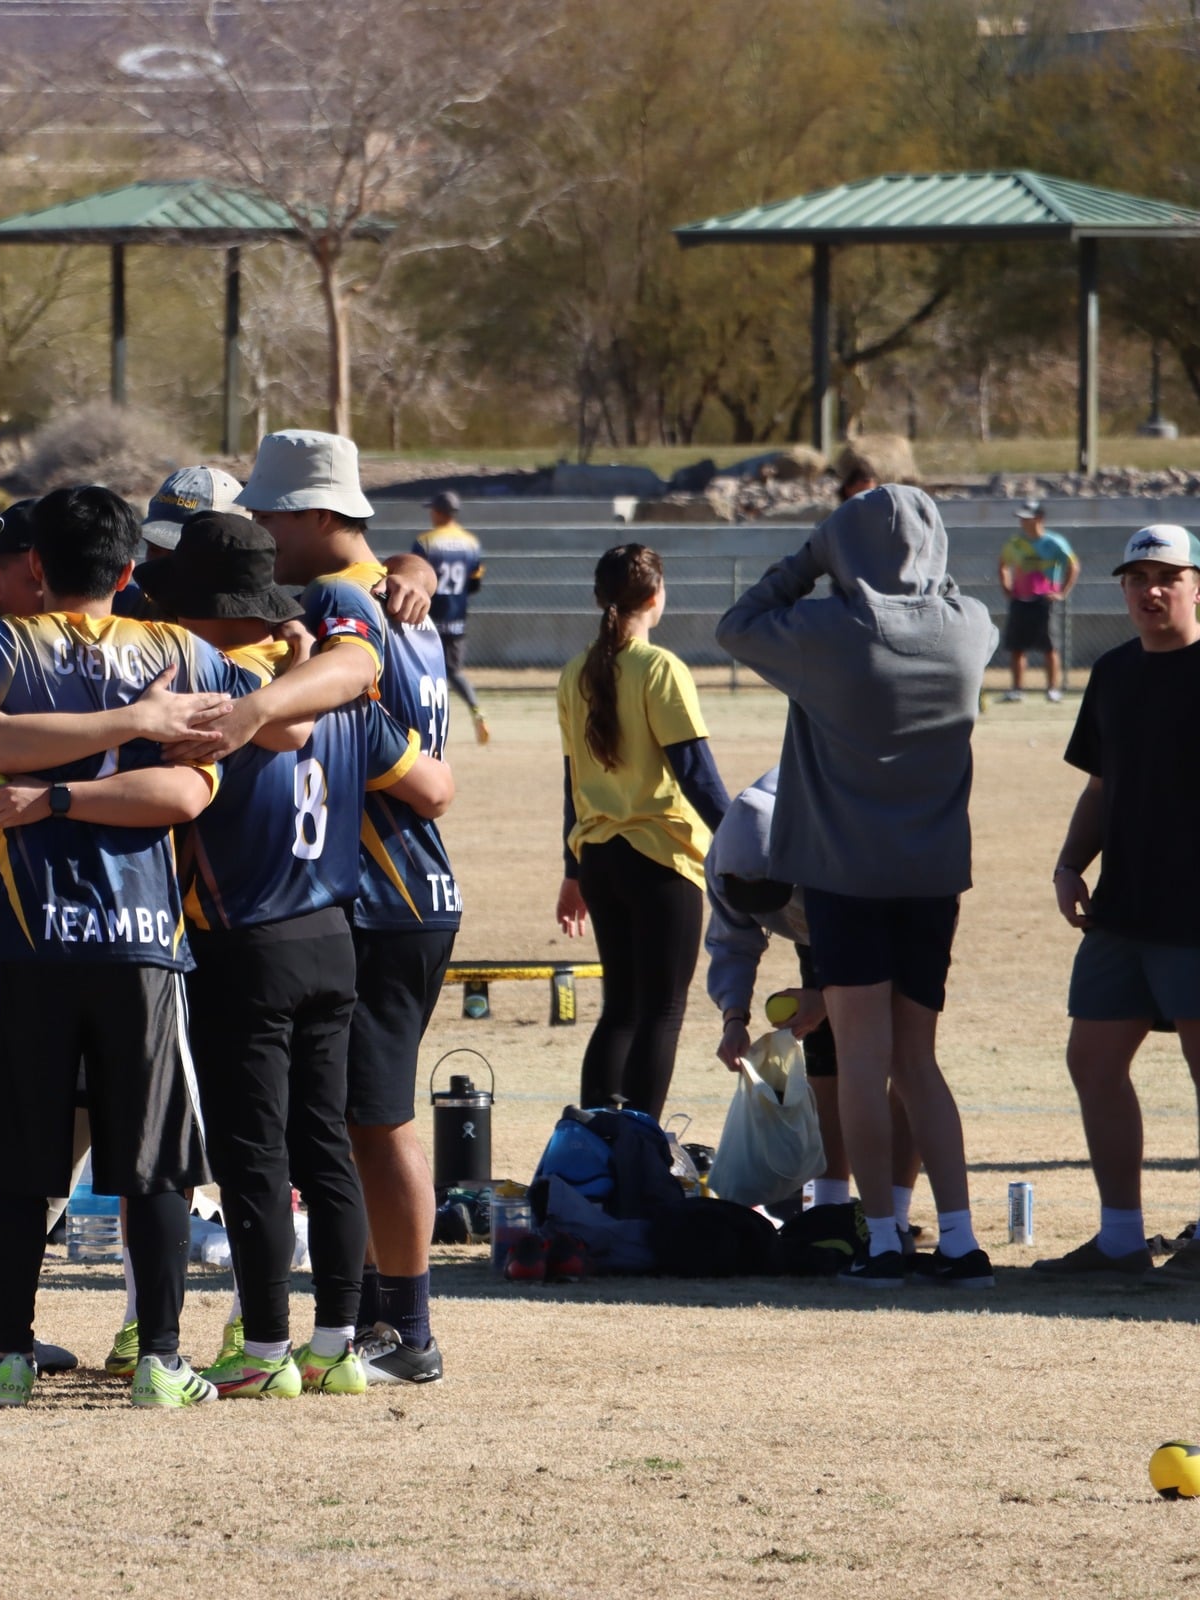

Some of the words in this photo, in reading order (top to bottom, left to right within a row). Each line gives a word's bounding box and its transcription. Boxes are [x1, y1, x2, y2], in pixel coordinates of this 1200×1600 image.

[437, 561, 466, 596] 29
[291, 757, 328, 861] 8
[42, 903, 170, 947] TEAMBC
